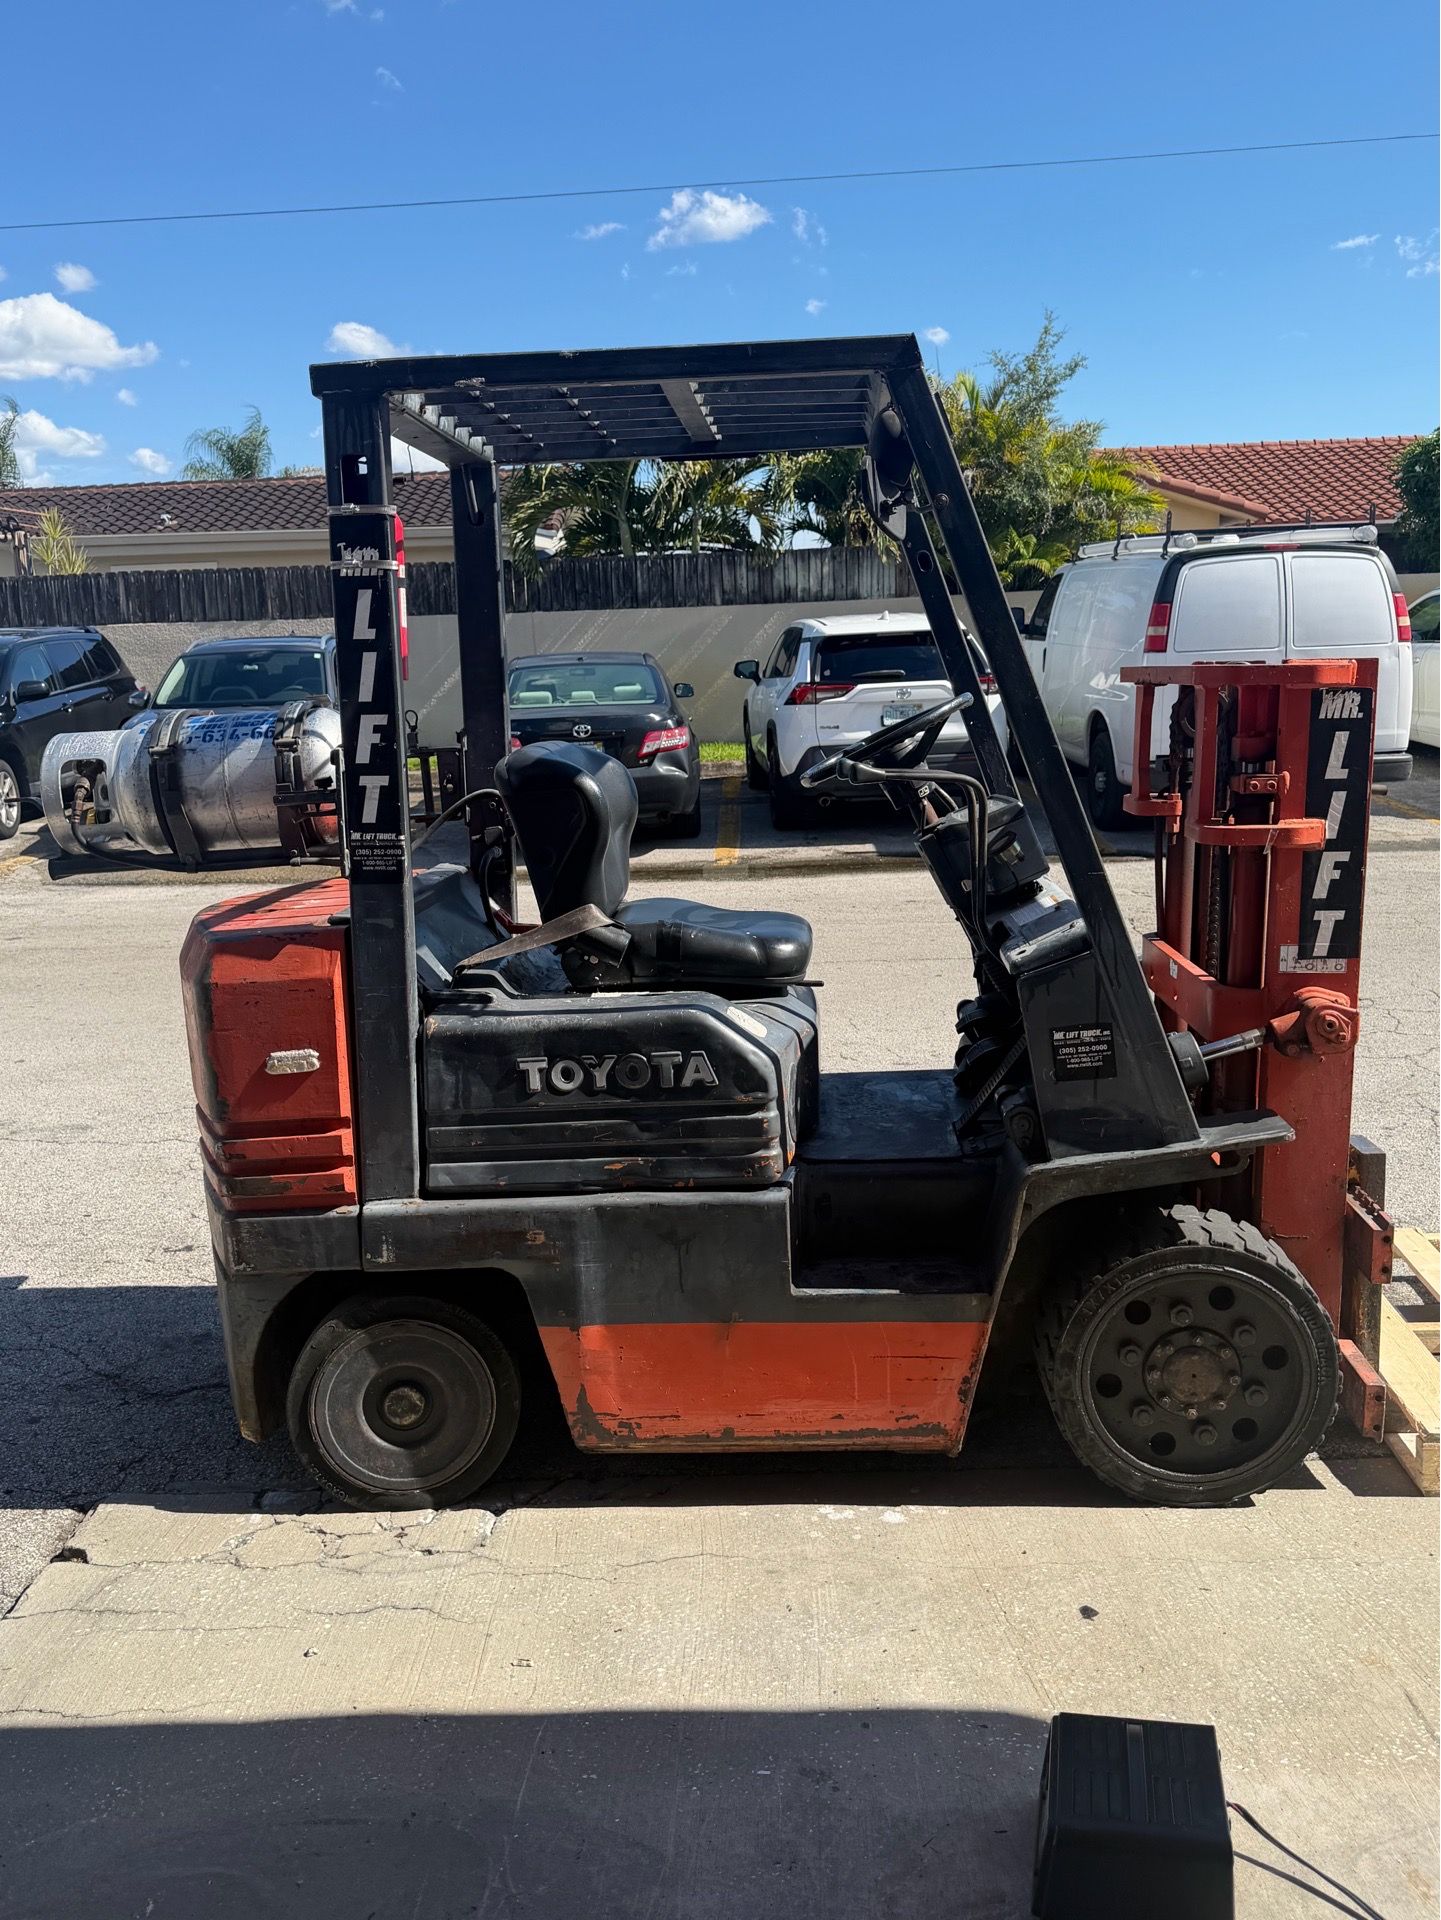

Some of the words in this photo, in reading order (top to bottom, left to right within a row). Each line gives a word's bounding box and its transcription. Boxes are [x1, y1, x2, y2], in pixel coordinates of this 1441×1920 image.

[353, 589, 389, 823] LIFT
[1318, 690, 1364, 719] MR.
[1312, 731, 1351, 957] LIFT
[1059, 1047, 1076, 1055] (305)
[1078, 1044, 1108, 1052] 252-0900
[1066, 1031, 1079, 1039] LIFT
[516, 1050, 719, 1093] TOYOTA
